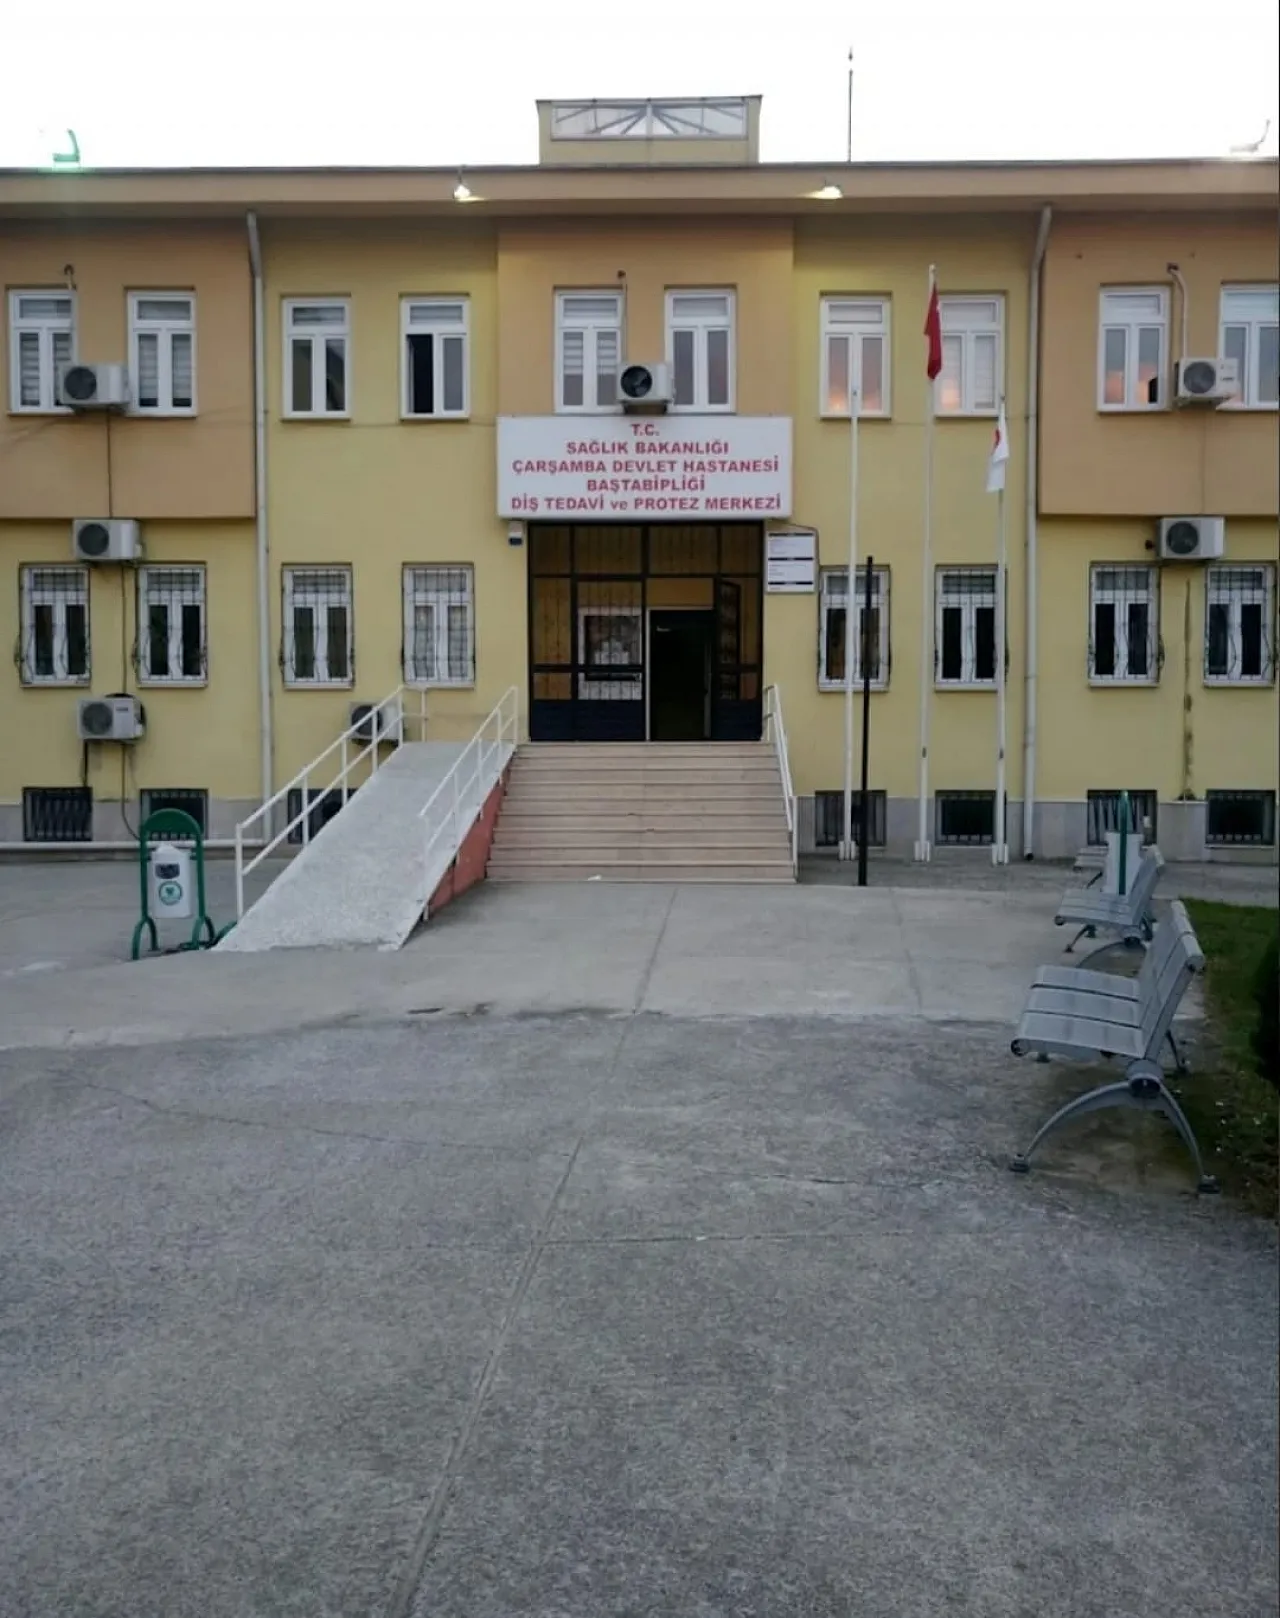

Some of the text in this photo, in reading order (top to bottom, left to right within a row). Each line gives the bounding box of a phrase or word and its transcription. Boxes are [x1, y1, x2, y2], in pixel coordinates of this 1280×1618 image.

[630, 423, 659, 436] T.C.
[566, 440, 729, 455] SAĞLIK BAKANLIĞI
[512, 454, 779, 475] ÇARŞAMBA DEVLET HASTANESİ
[511, 493, 781, 512] DİŞ TEDAVİ ve PROTEZ MERKEZİ
